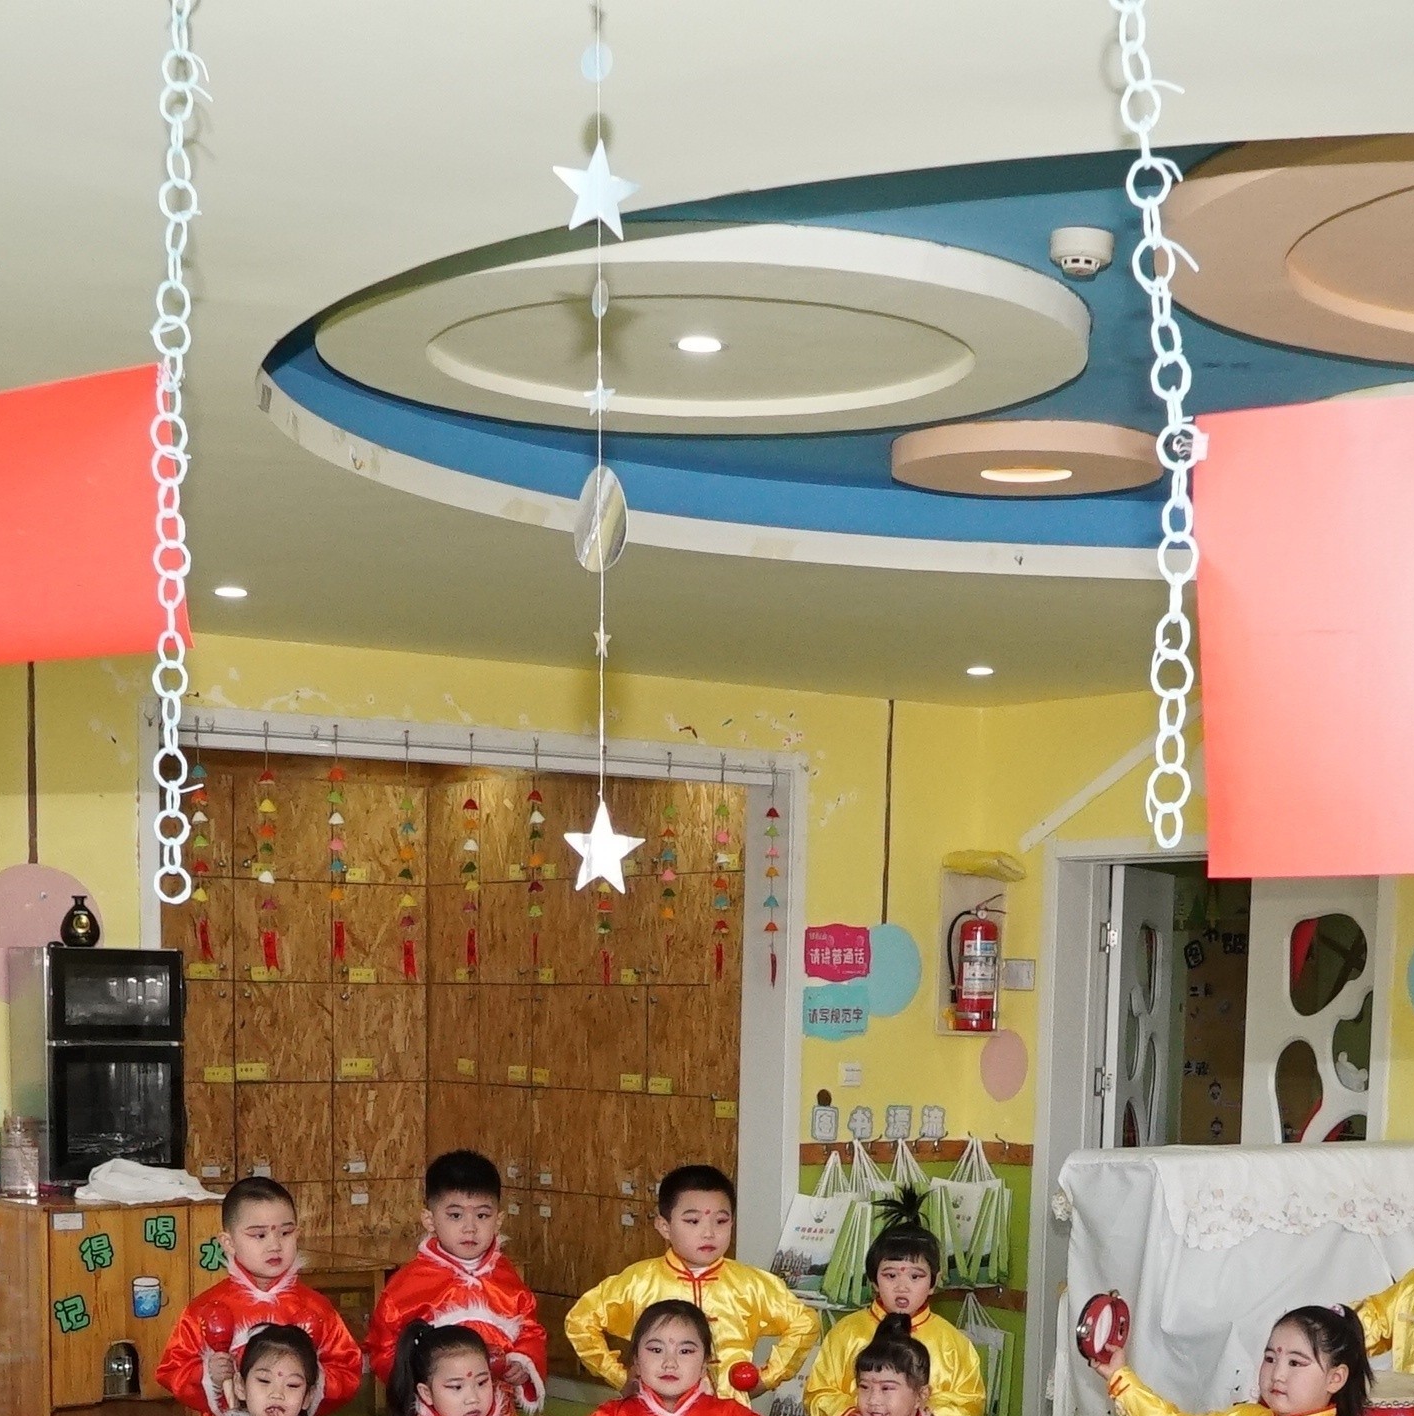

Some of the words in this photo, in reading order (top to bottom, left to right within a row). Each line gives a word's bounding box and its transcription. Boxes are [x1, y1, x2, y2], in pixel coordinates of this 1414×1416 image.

[807, 1006, 864, 1024] 请写规范字
